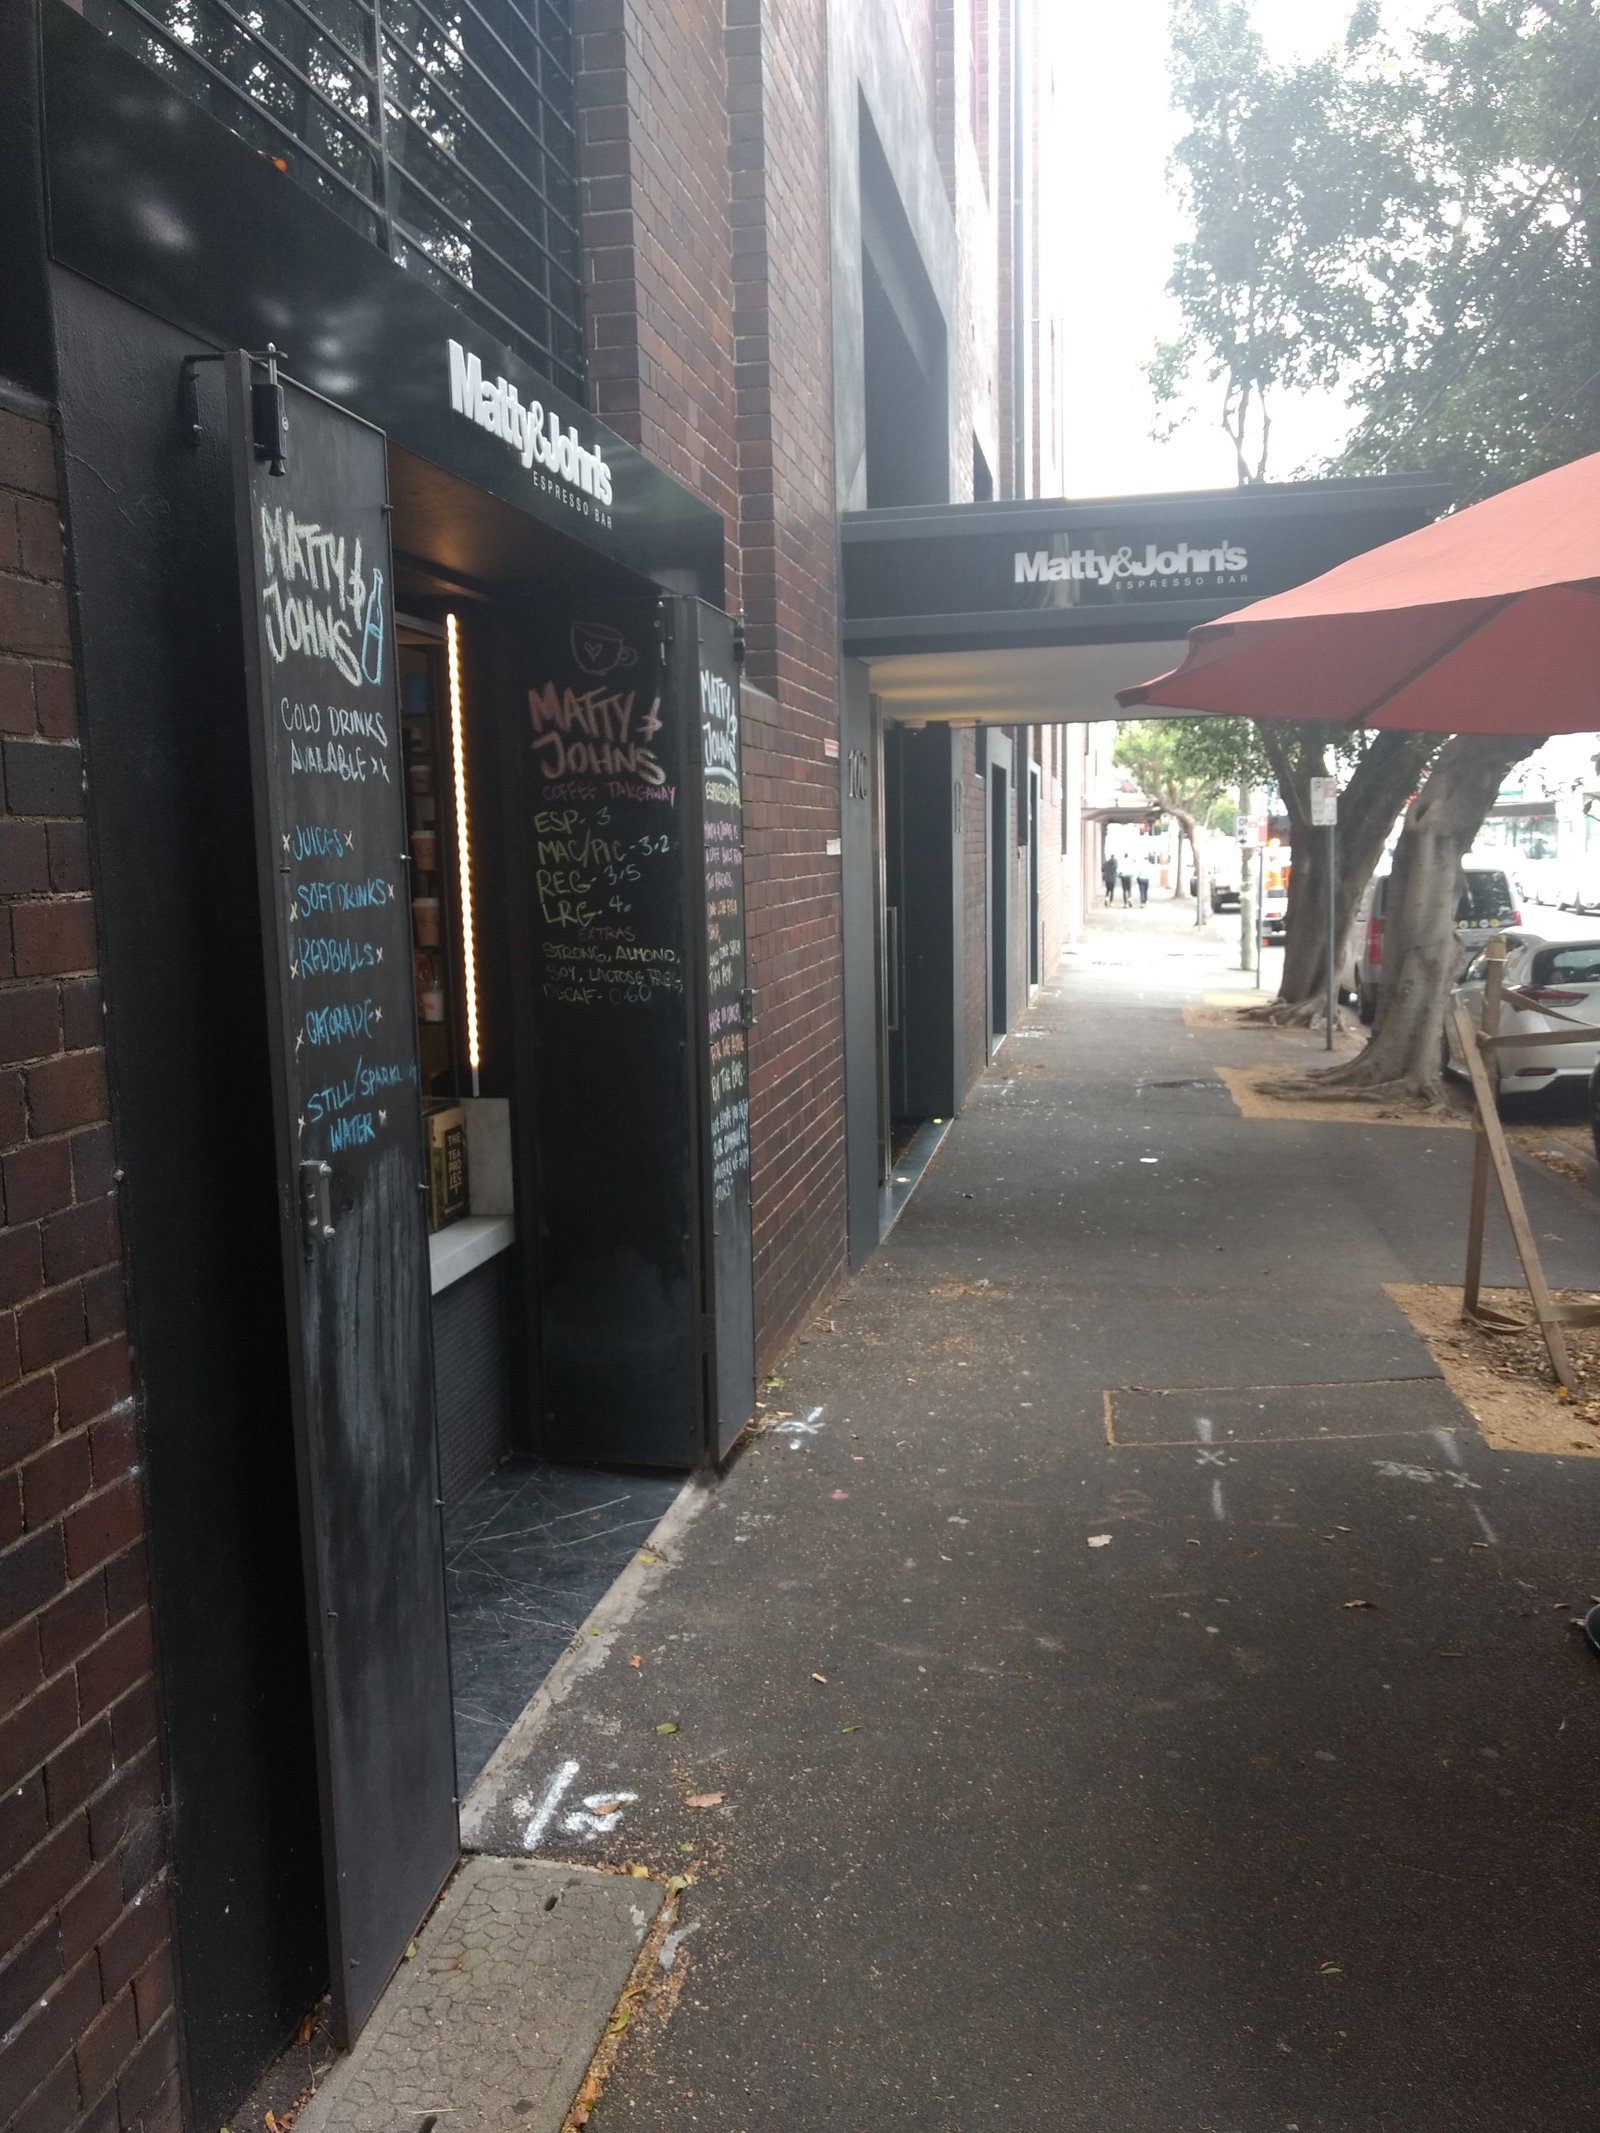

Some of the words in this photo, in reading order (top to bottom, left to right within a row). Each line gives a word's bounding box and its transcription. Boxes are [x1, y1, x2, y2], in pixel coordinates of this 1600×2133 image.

[448, 338, 613, 506] Matty&John's
[533, 470, 589, 516] ESPRESSO
[594, 508, 613, 530] BAR
[261, 505, 346, 611] MATTY
[1014, 540, 1249, 585] Matty&John's
[1115, 576, 1205, 590] ESPRESSO
[1216, 574, 1249, 585] BAR
[263, 582, 363, 687] JOHNS
[281, 697, 320, 733] COLD
[327, 706, 388, 748] DRINKS
[528, 680, 636, 743] MATTY
[700, 669, 731, 734] MATTY
[291, 739, 366, 783] AVAILABLE
[530, 730, 667, 785] JOHNS
[702, 721, 737, 773] JOHNS
[542, 781, 597, 801] COFFEE
[606, 780, 676, 808] TAKEAWAY
[596, 806, 612, 825] 3
[292, 825, 344, 861] JUICES
[297, 882, 334, 918] SOFT
[337, 879, 388, 910] DRINKS
[578, 927, 636, 942] EXTRAS
[588, 968, 645, 986] LACTOSE
[305, 1000, 374, 1046] GATORADE
[330, 1112, 376, 1153] WATER
[448, 1132, 461, 1146] THE
[448, 1149, 461, 1161] TEA
[448, 1159, 463, 1174] PRO
